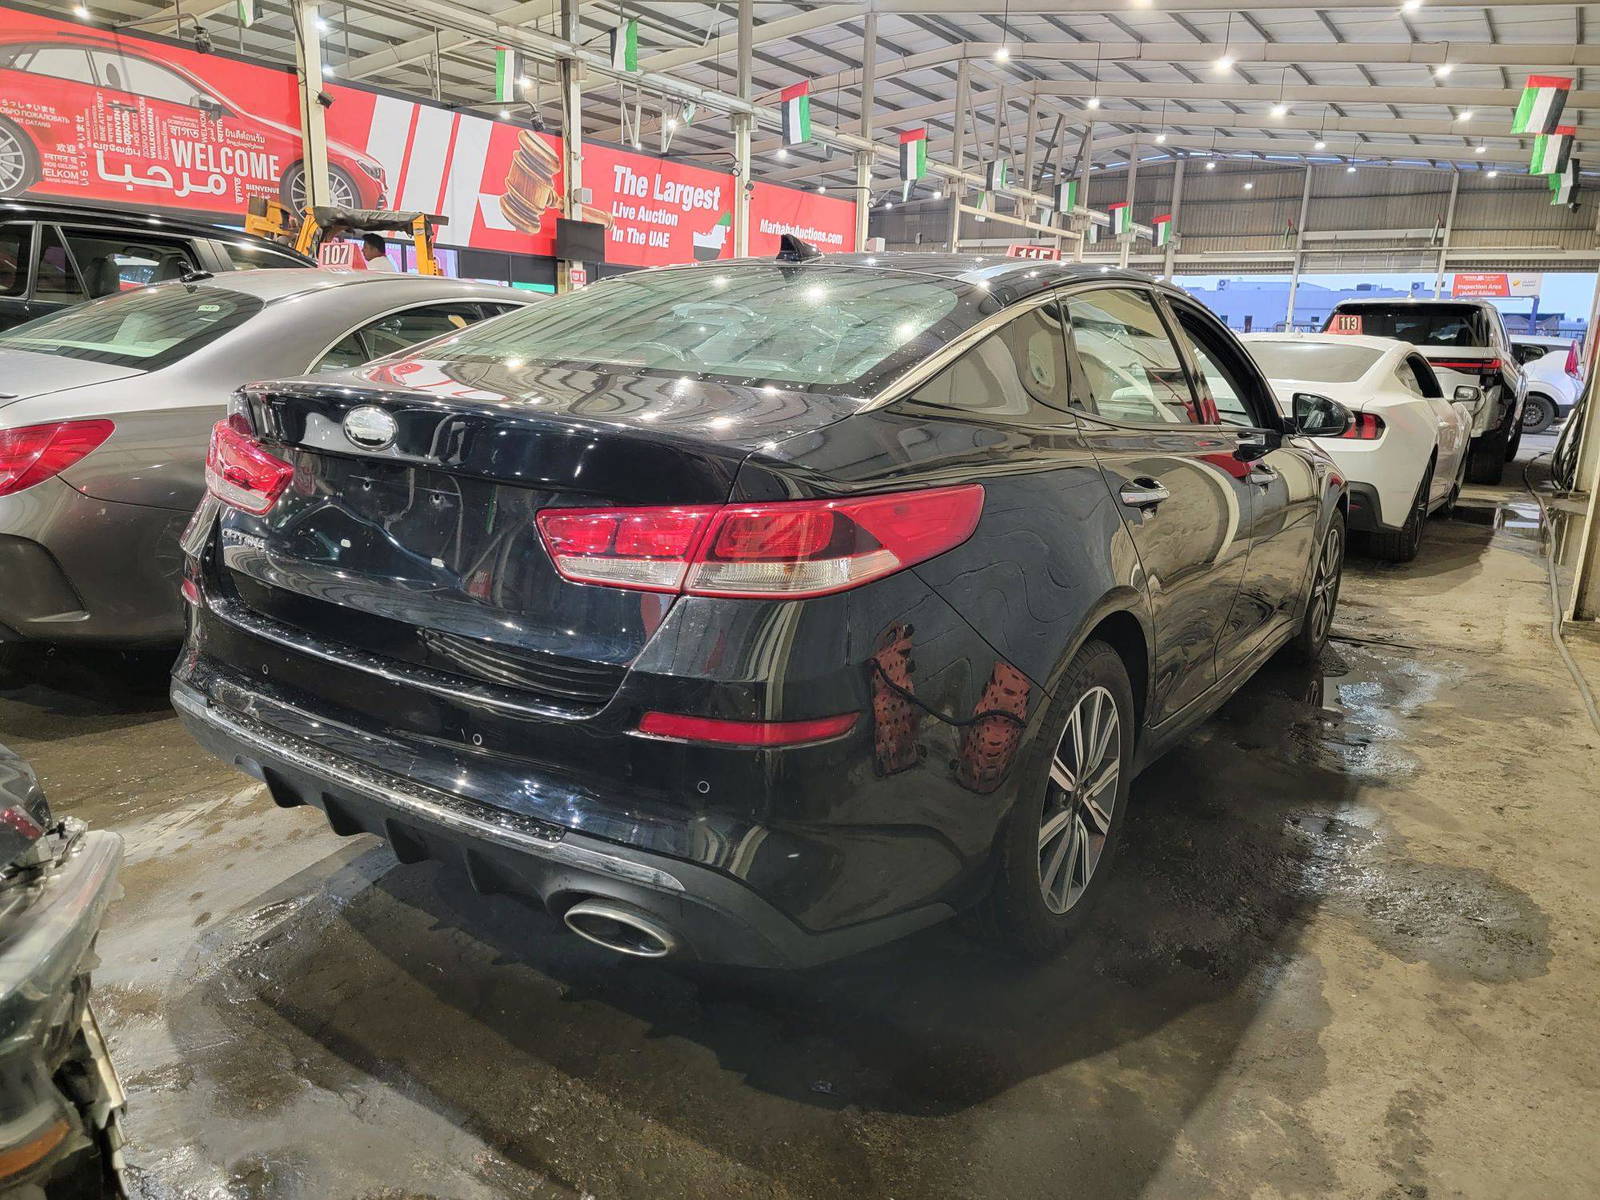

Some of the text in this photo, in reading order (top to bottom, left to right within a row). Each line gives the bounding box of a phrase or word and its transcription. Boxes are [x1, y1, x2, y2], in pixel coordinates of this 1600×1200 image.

[96, 149, 227, 197] مرحبا
[170, 138, 280, 182] WELCOME
[613, 165, 720, 211] The Largest
[612, 201, 679, 227] Live Auction
[627, 227, 646, 245] The
[648, 231, 671, 248] UAE
[324, 244, 348, 265] 107
[1340, 316, 1358, 330] 113
